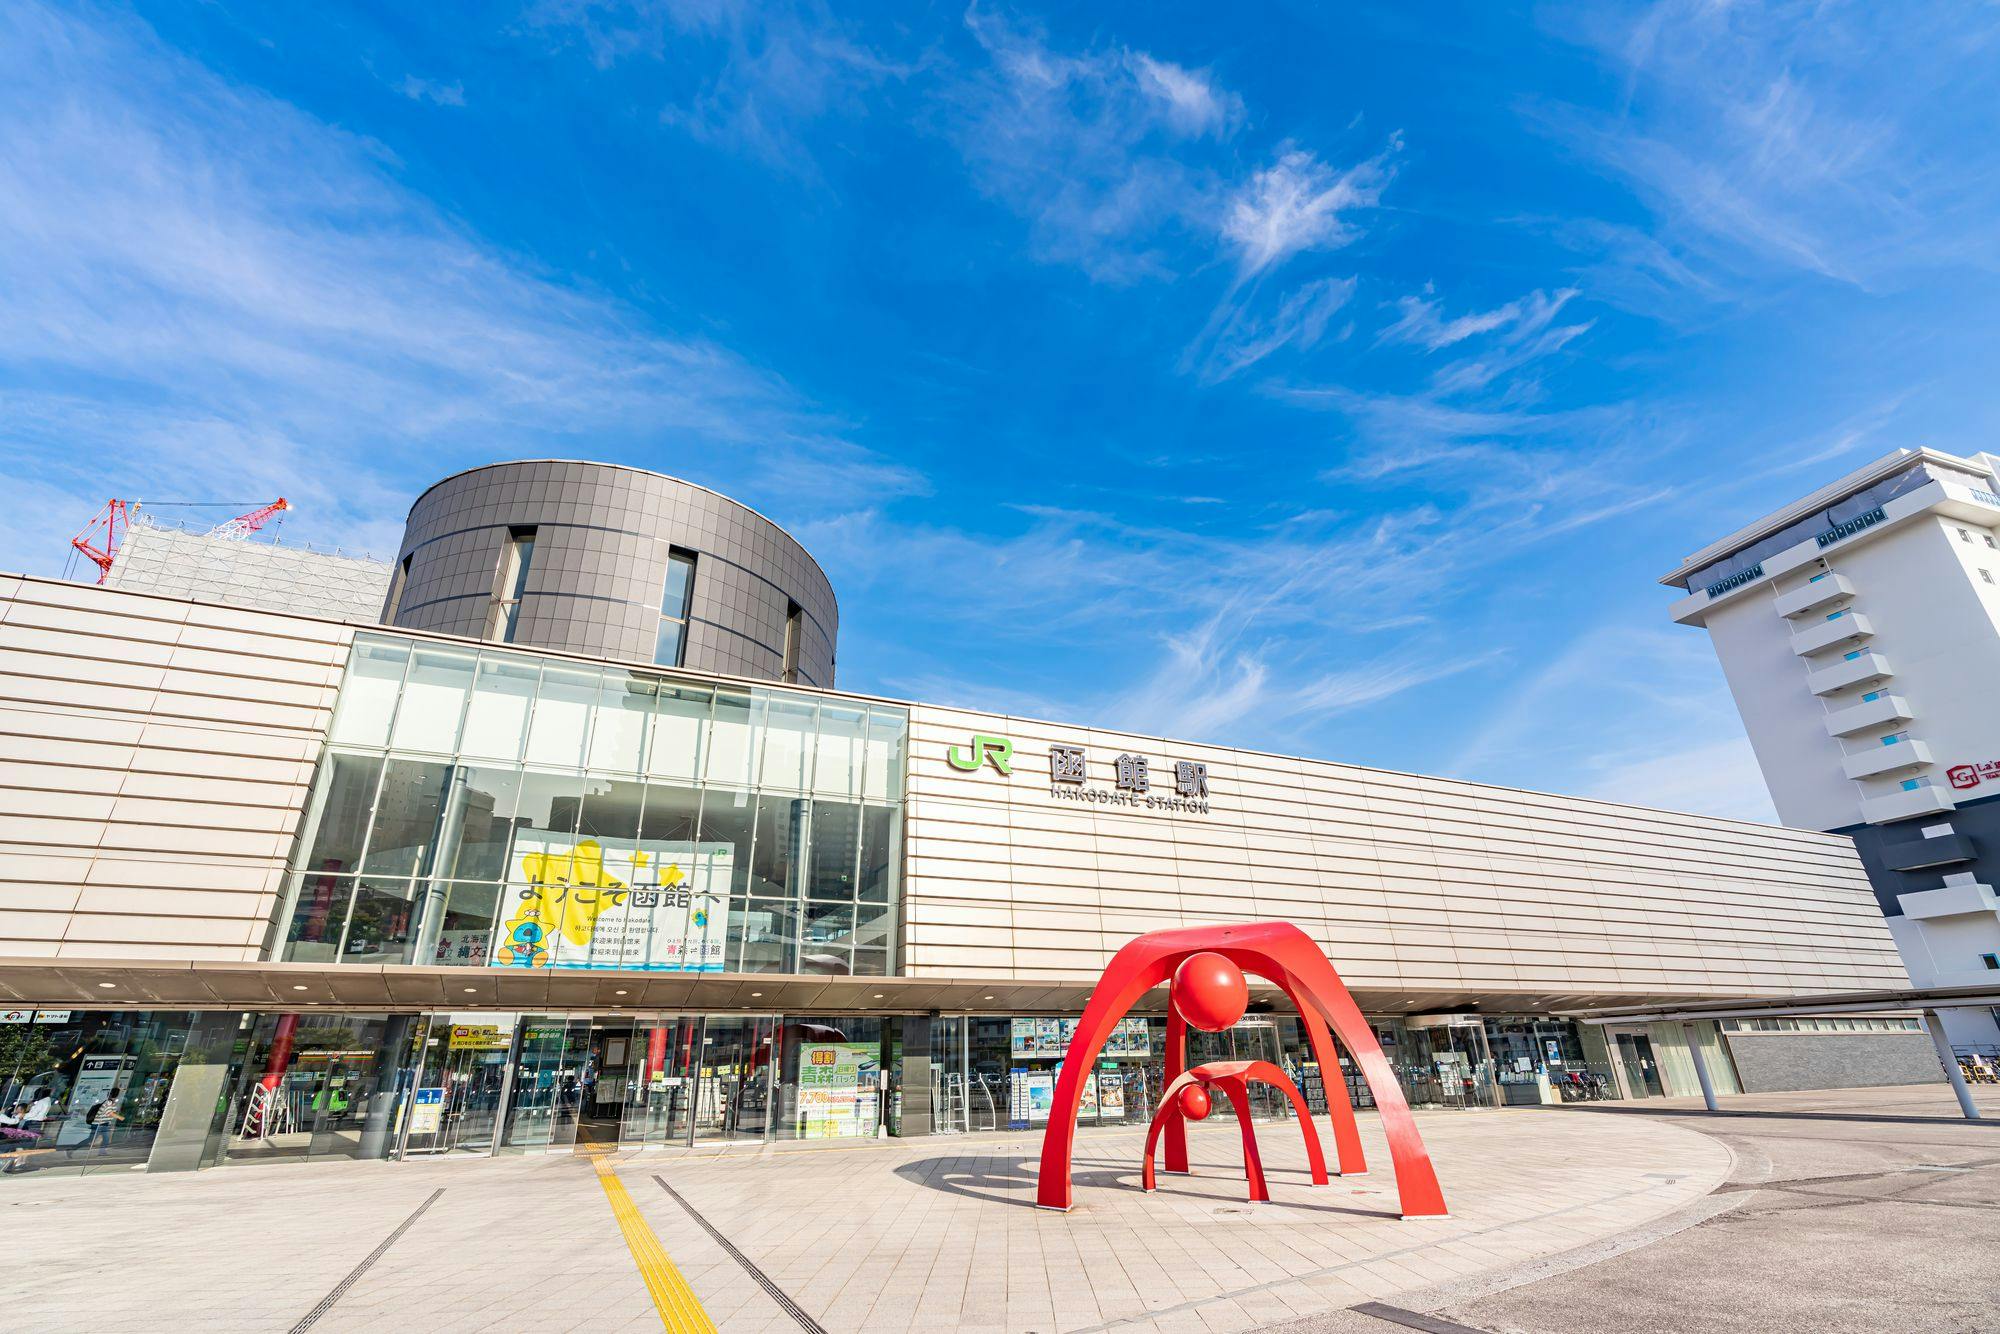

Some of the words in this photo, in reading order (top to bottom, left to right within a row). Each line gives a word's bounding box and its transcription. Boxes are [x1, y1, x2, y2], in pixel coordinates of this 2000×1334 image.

[948, 734, 1013, 775] JR
[1049, 744, 1209, 798] 函館駅
[1050, 785, 1140, 807] HAKODATE
[1146, 796, 1209, 815] STATION
[519, 874, 721, 909] ようこそ函館へ
[587, 915, 615, 923] Welcome
[801, 1066, 834, 1083] 青森
